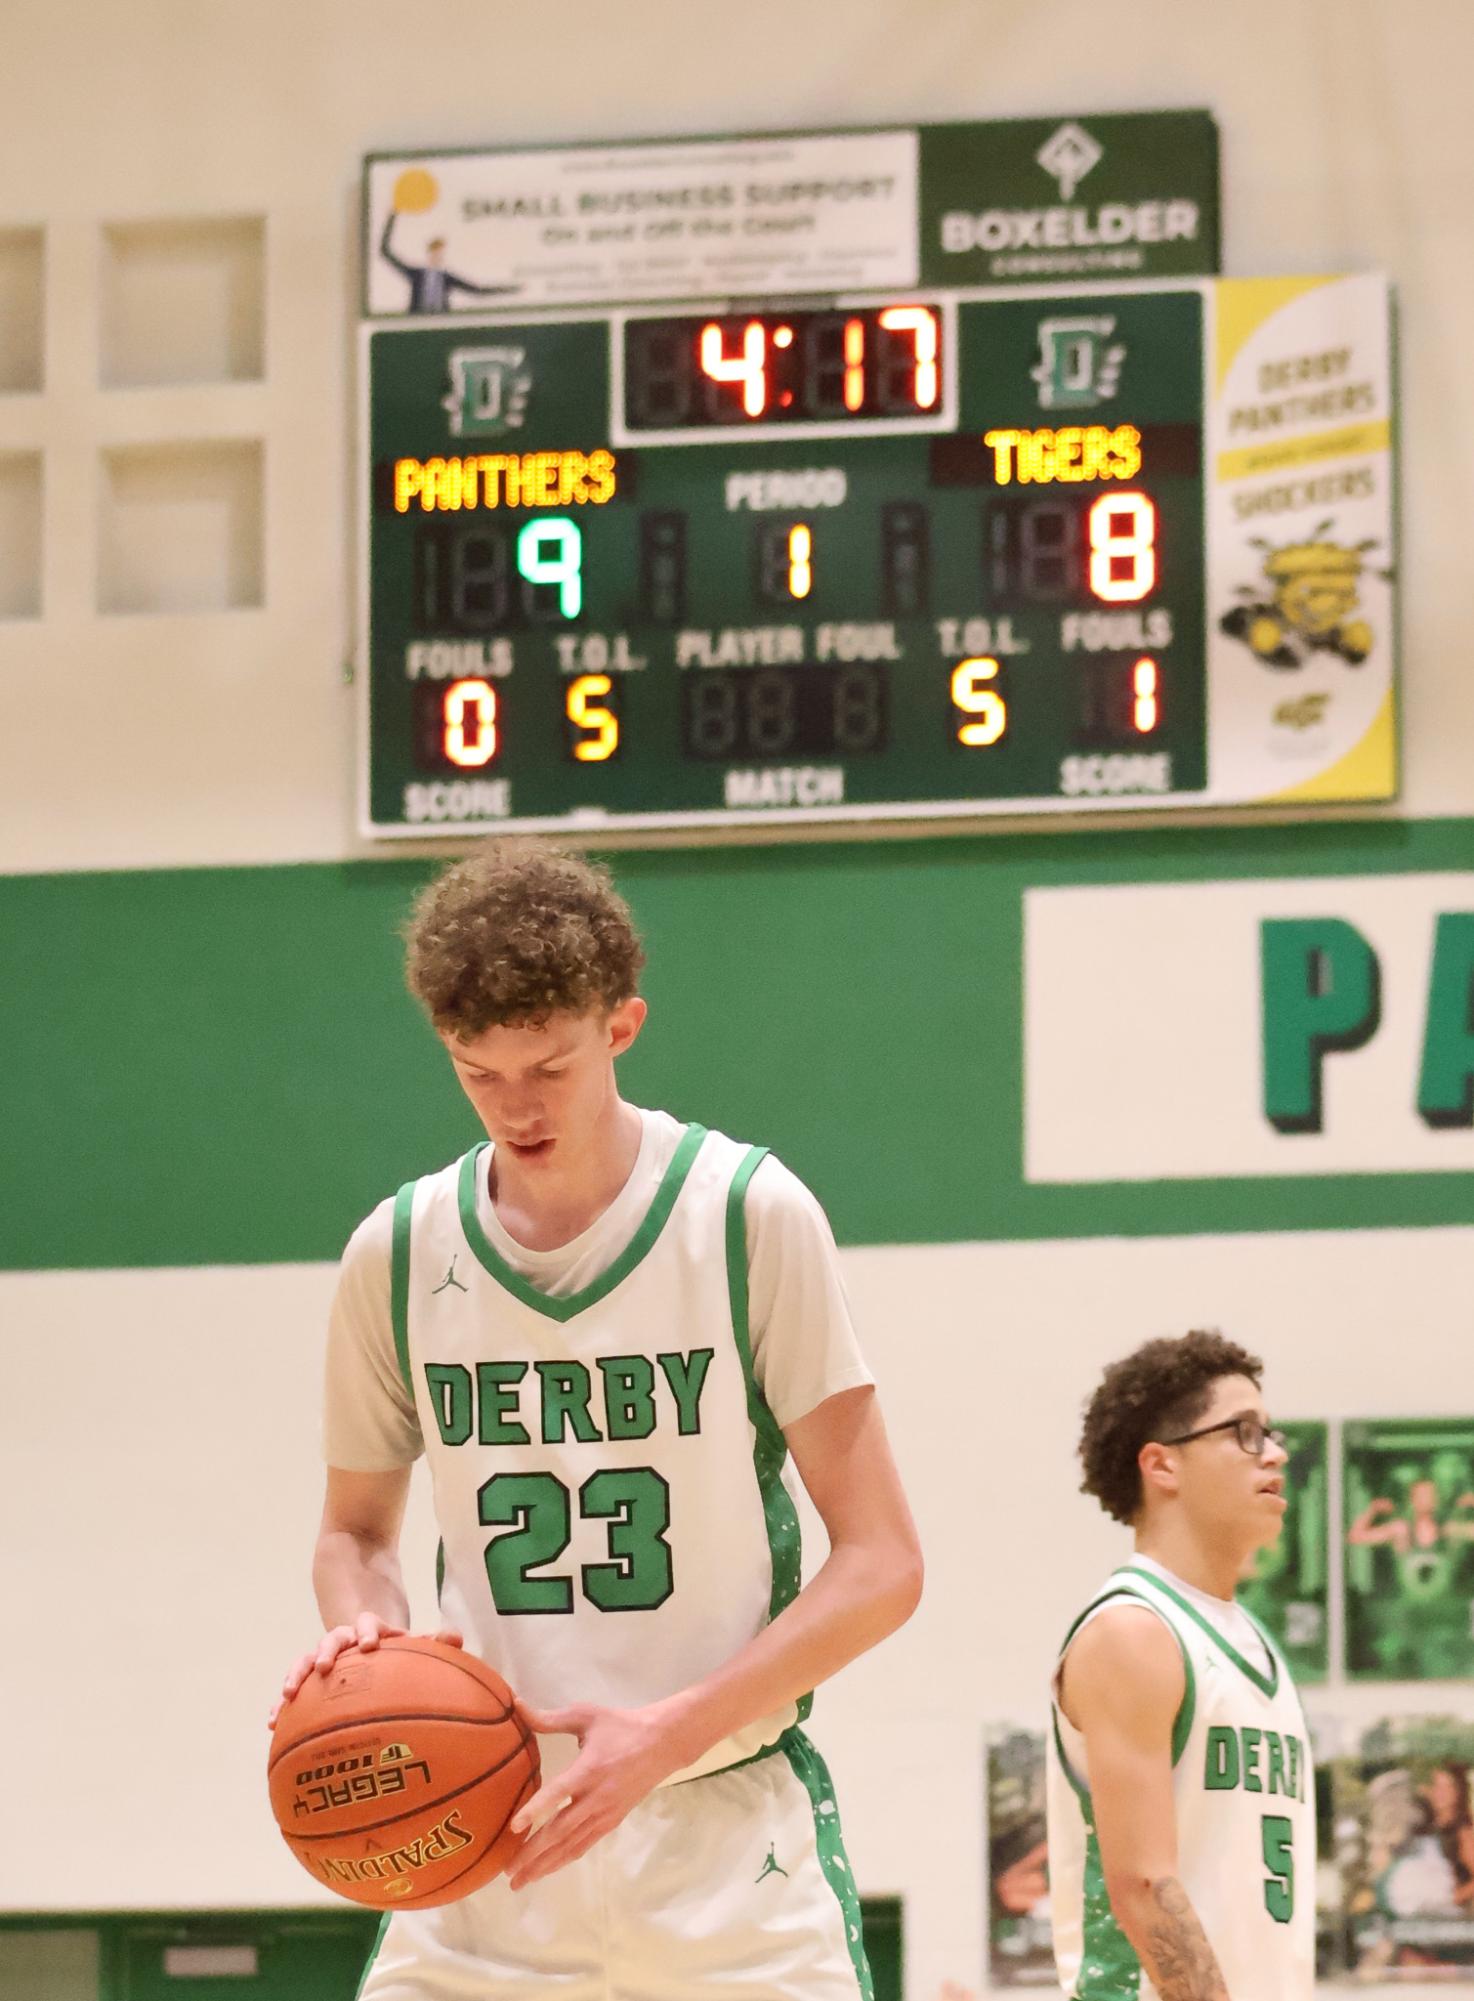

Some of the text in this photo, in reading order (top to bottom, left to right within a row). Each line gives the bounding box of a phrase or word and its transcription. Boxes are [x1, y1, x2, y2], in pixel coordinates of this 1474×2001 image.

[461, 176, 895, 222] SMALL BUSINESS SUPPORT
[941, 202, 1197, 253] BOXELDER
[700, 307, 940, 416] 4:17
[1259, 347, 1352, 394] DERBY
[1228, 381, 1376, 436] PANTHERS
[394, 450, 616, 512] PANTHERS
[984, 425, 1142, 486] TIGERS
[725, 469, 848, 511] PERIOD
[1232, 468, 1375, 522] SHOCKERS
[517, 517, 582, 619] 9
[788, 523, 812, 598] 1
[1088, 490, 1157, 602] 8
[405, 639, 513, 680] FOULS
[555, 634, 648, 674] T.O.L.
[675, 621, 904, 668] PLAYER FOUL
[937, 616, 1030, 658] T.O.L.
[1060, 610, 1173, 652] FOULS
[443, 678, 499, 768] 0
[565, 674, 619, 762] 5
[950, 656, 1007, 746] 5
[1133, 656, 1158, 733] 1
[404, 778, 512, 821] SCORE
[724, 766, 845, 807] MATCH
[1059, 754, 1172, 795] SCORE
[424, 1348, 714, 1446] DERBY
[476, 1466, 674, 1615] 23
[293, 1759, 432, 1818] LEGACY
[296, 1754, 373, 1786] 1000
[317, 1809, 474, 1883] SPALDIN
[1261, 1814, 1294, 1923] 5
